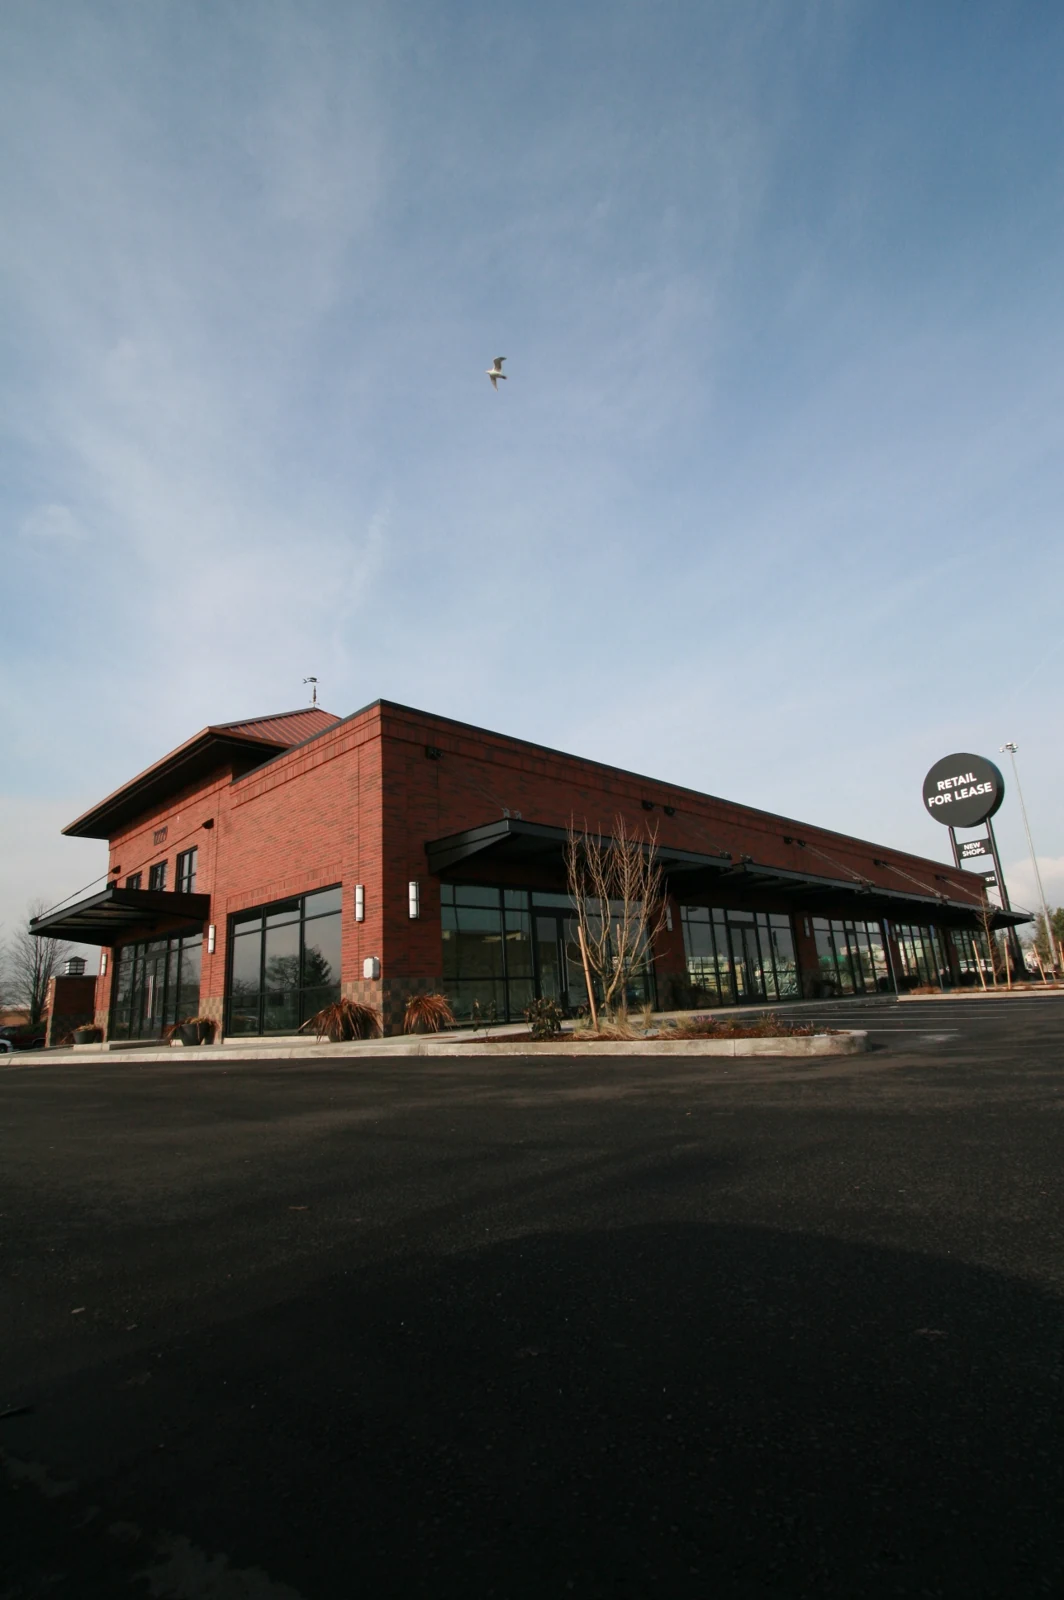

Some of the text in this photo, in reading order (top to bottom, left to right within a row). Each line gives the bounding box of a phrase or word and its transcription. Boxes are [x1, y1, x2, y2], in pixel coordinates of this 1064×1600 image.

[937, 772, 977, 791] RETAIL
[928, 782, 993, 807] FOR LEASE
[962, 847, 986, 857] SHOPS
[963, 841, 981, 850] NEW
